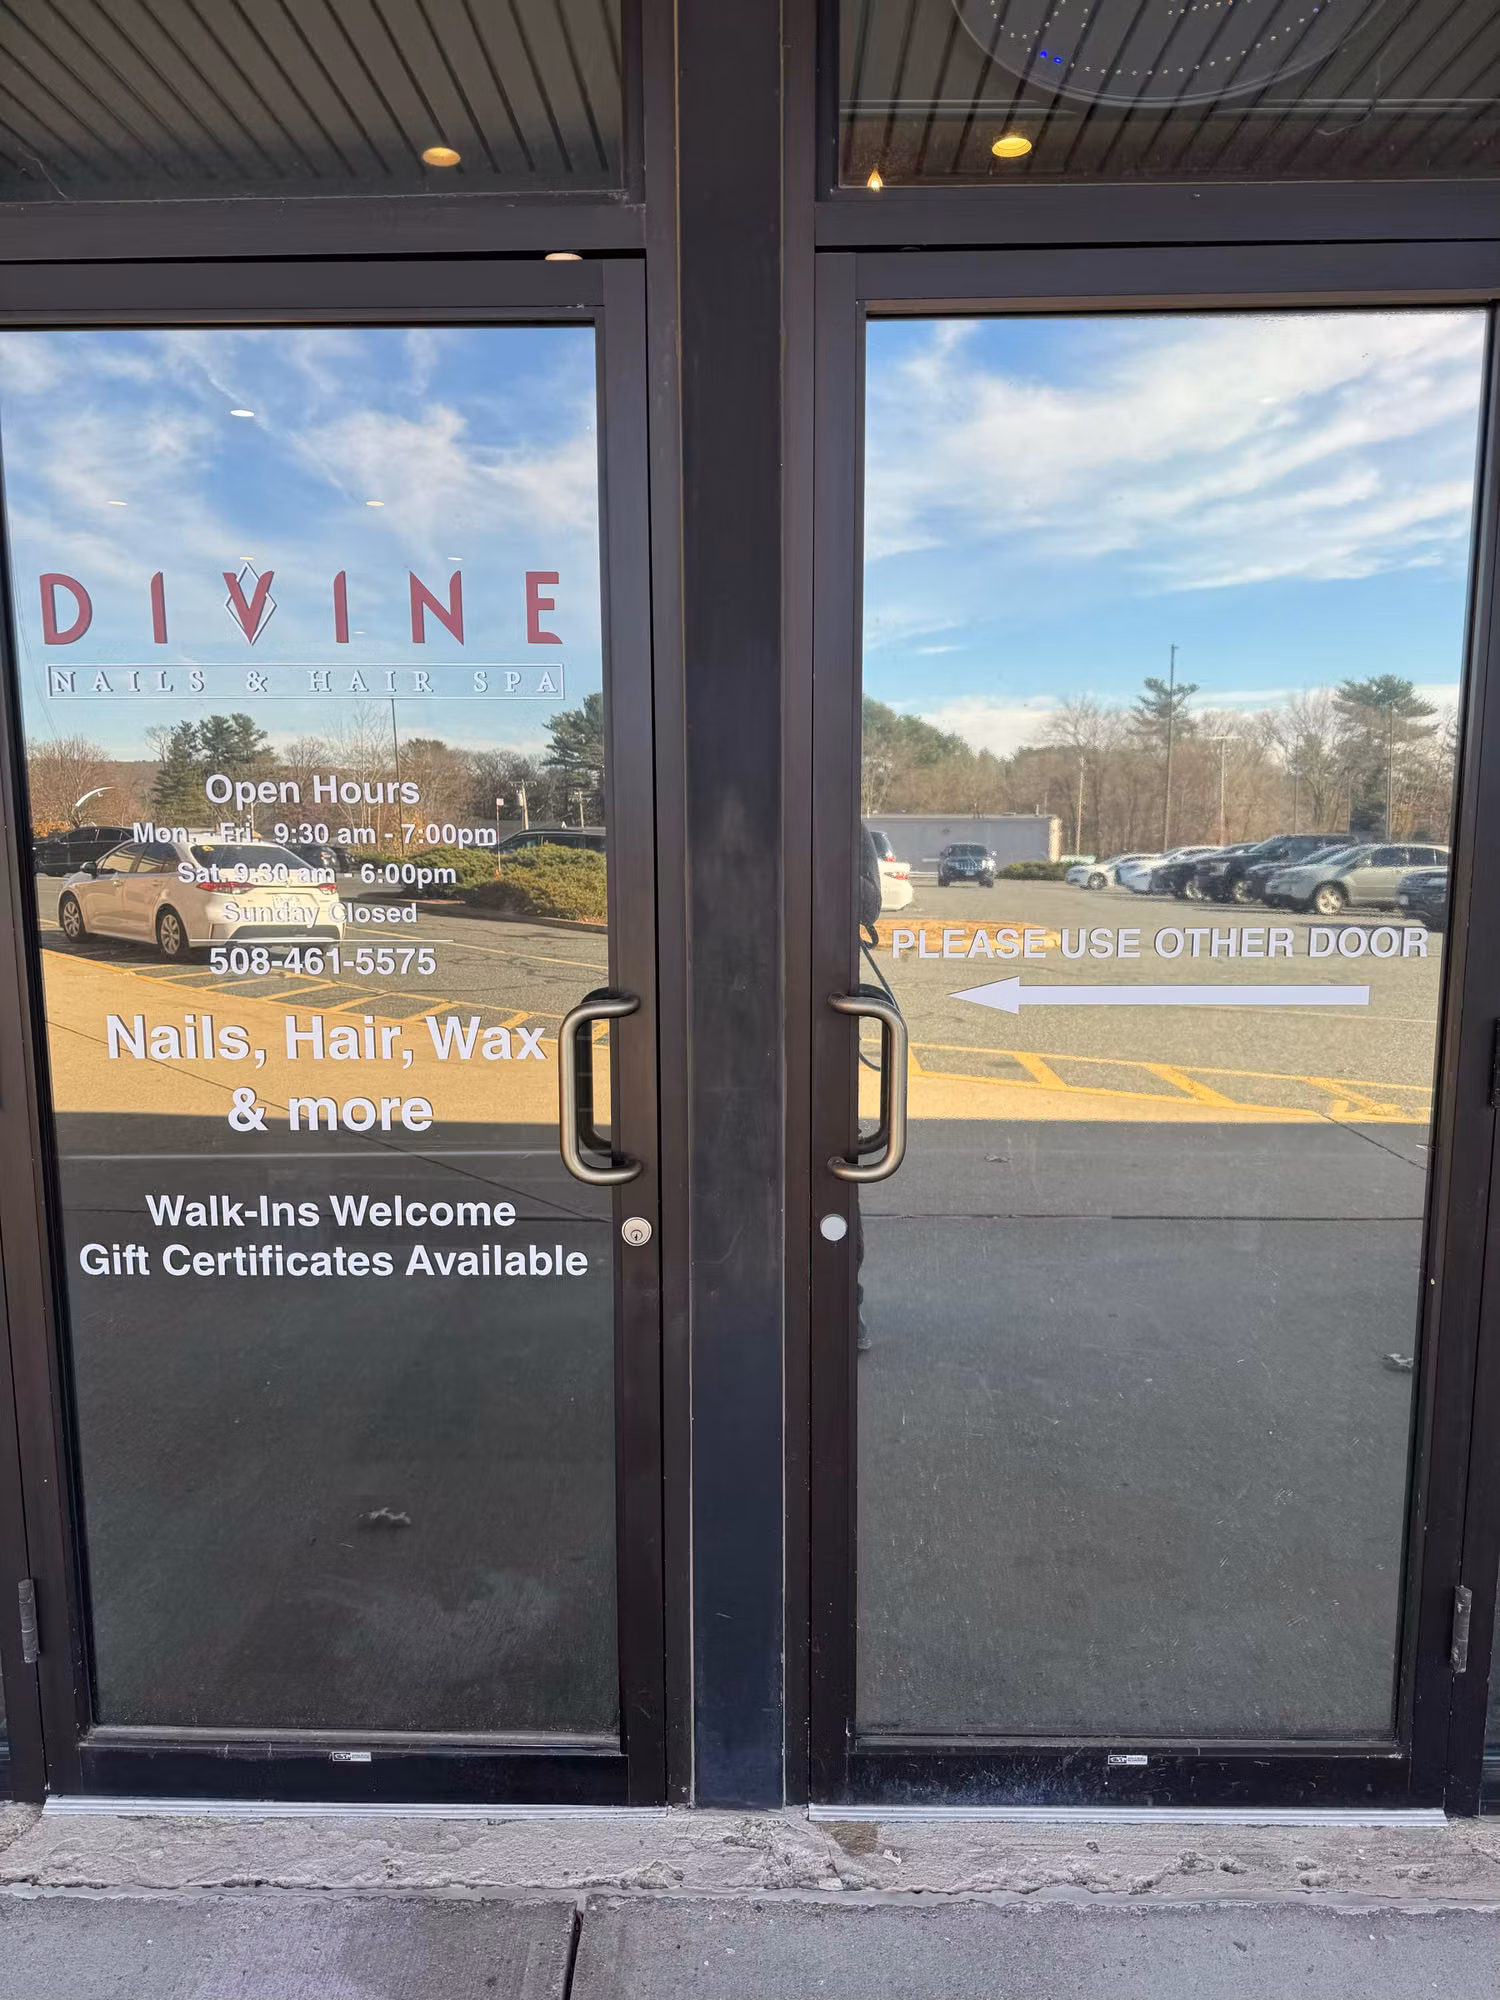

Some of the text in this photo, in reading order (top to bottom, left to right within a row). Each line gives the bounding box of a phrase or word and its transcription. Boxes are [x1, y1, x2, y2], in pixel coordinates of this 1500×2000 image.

[39, 570, 563, 646] DIVINE
[52, 670, 558, 693] NAILS & HAIR SPA
[205, 774, 420, 811] Open Hours
[133, 822, 195, 843] Mon.
[220, 822, 258, 843] Fri.
[274, 823, 330, 844] 9:30
[337, 827, 376, 844] am
[401, 823, 498, 849] 7:00pm
[177, 862, 228, 883] Sat.
[233, 863, 289, 883] 9:30
[297, 866, 336, 884] am
[360, 863, 457, 888] 6:00pm
[222, 902, 320, 928] Sunday
[328, 902, 418, 923] Closed
[892, 927, 1430, 959] PLEASE USE OTHER DOOR
[208, 947, 438, 976] 508-461-5575
[107, 1014, 547, 1069] Nails, Hair, Wax
[227, 1087, 435, 1133] & more
[145, 1194, 517, 1228] Walk-Ins Welcome
[78, 1244, 589, 1278] Gift Certificates Available
